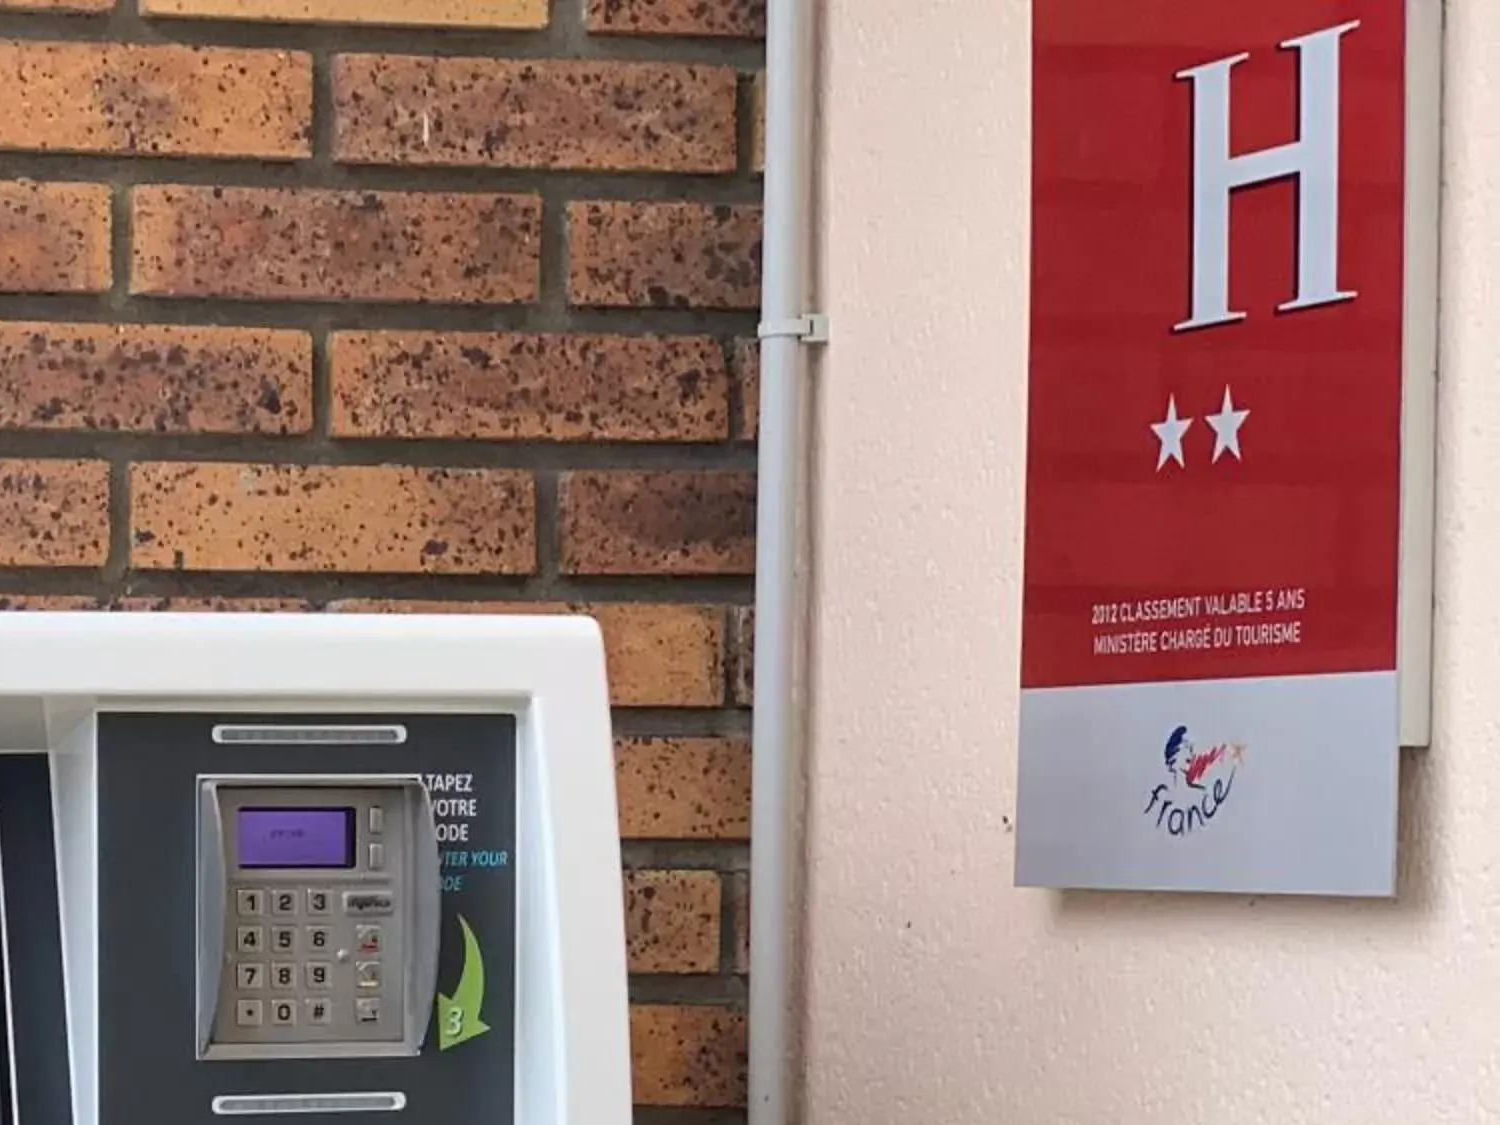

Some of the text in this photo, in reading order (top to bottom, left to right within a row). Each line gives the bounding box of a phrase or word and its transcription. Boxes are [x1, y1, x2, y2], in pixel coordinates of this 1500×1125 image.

[1170, 20, 1360, 331] H
[1091, 588, 1305, 624] 2012 CLASSEMENT VALABLE 5 ANS
[1093, 621, 1301, 655] MINISTÈRE CHARGÉ DU TOURISME
[425, 773, 473, 792] TAPEZ
[435, 823, 469, 842] ODE
[471, 850, 508, 867] YOUR
[246, 894, 326, 911] 1 2 3
[243, 931, 325, 948] 4 5 6
[245, 967, 325, 985] 7 8 9
[278, 1004, 291, 1021] 0
[445, 1006, 463, 1036] 3
